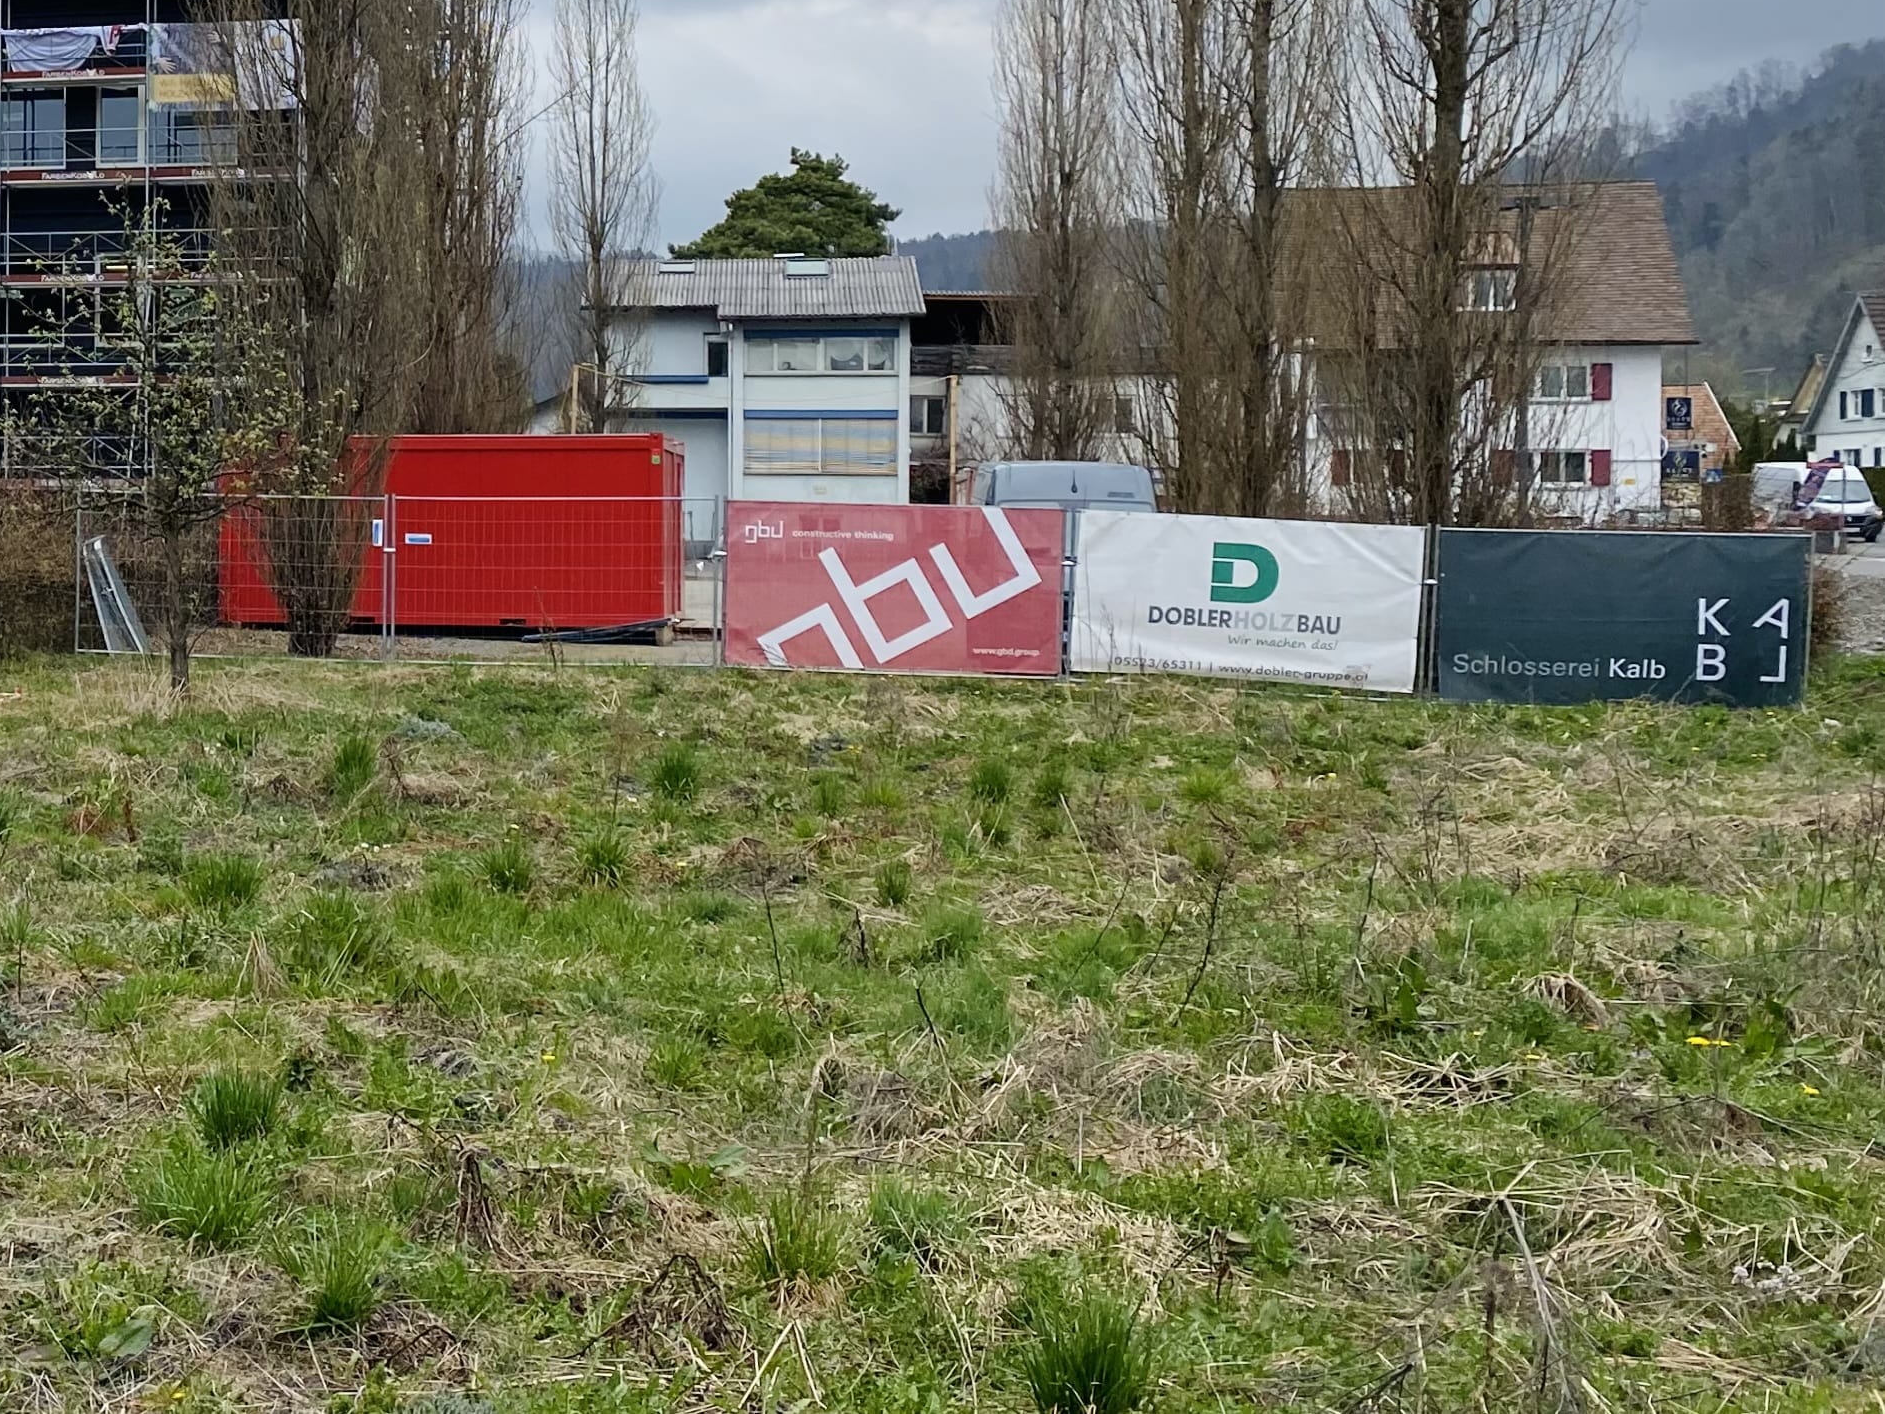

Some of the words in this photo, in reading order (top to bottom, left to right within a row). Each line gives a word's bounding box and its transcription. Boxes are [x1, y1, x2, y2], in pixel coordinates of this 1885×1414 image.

[792, 530, 852, 540] constructive
[854, 530, 894, 542] thinking
[1148, 606, 1342, 635] DOBLERHOLZBAU
[1227, 634, 1251, 646] Wir
[1256, 637, 1306, 650] machen
[1311, 639, 1339, 651] das!
[972, 647, 1041, 658] www.gbd.group
[1452, 653, 1600, 678] Schlosserei
[1609, 658, 1666, 679] Kalb
